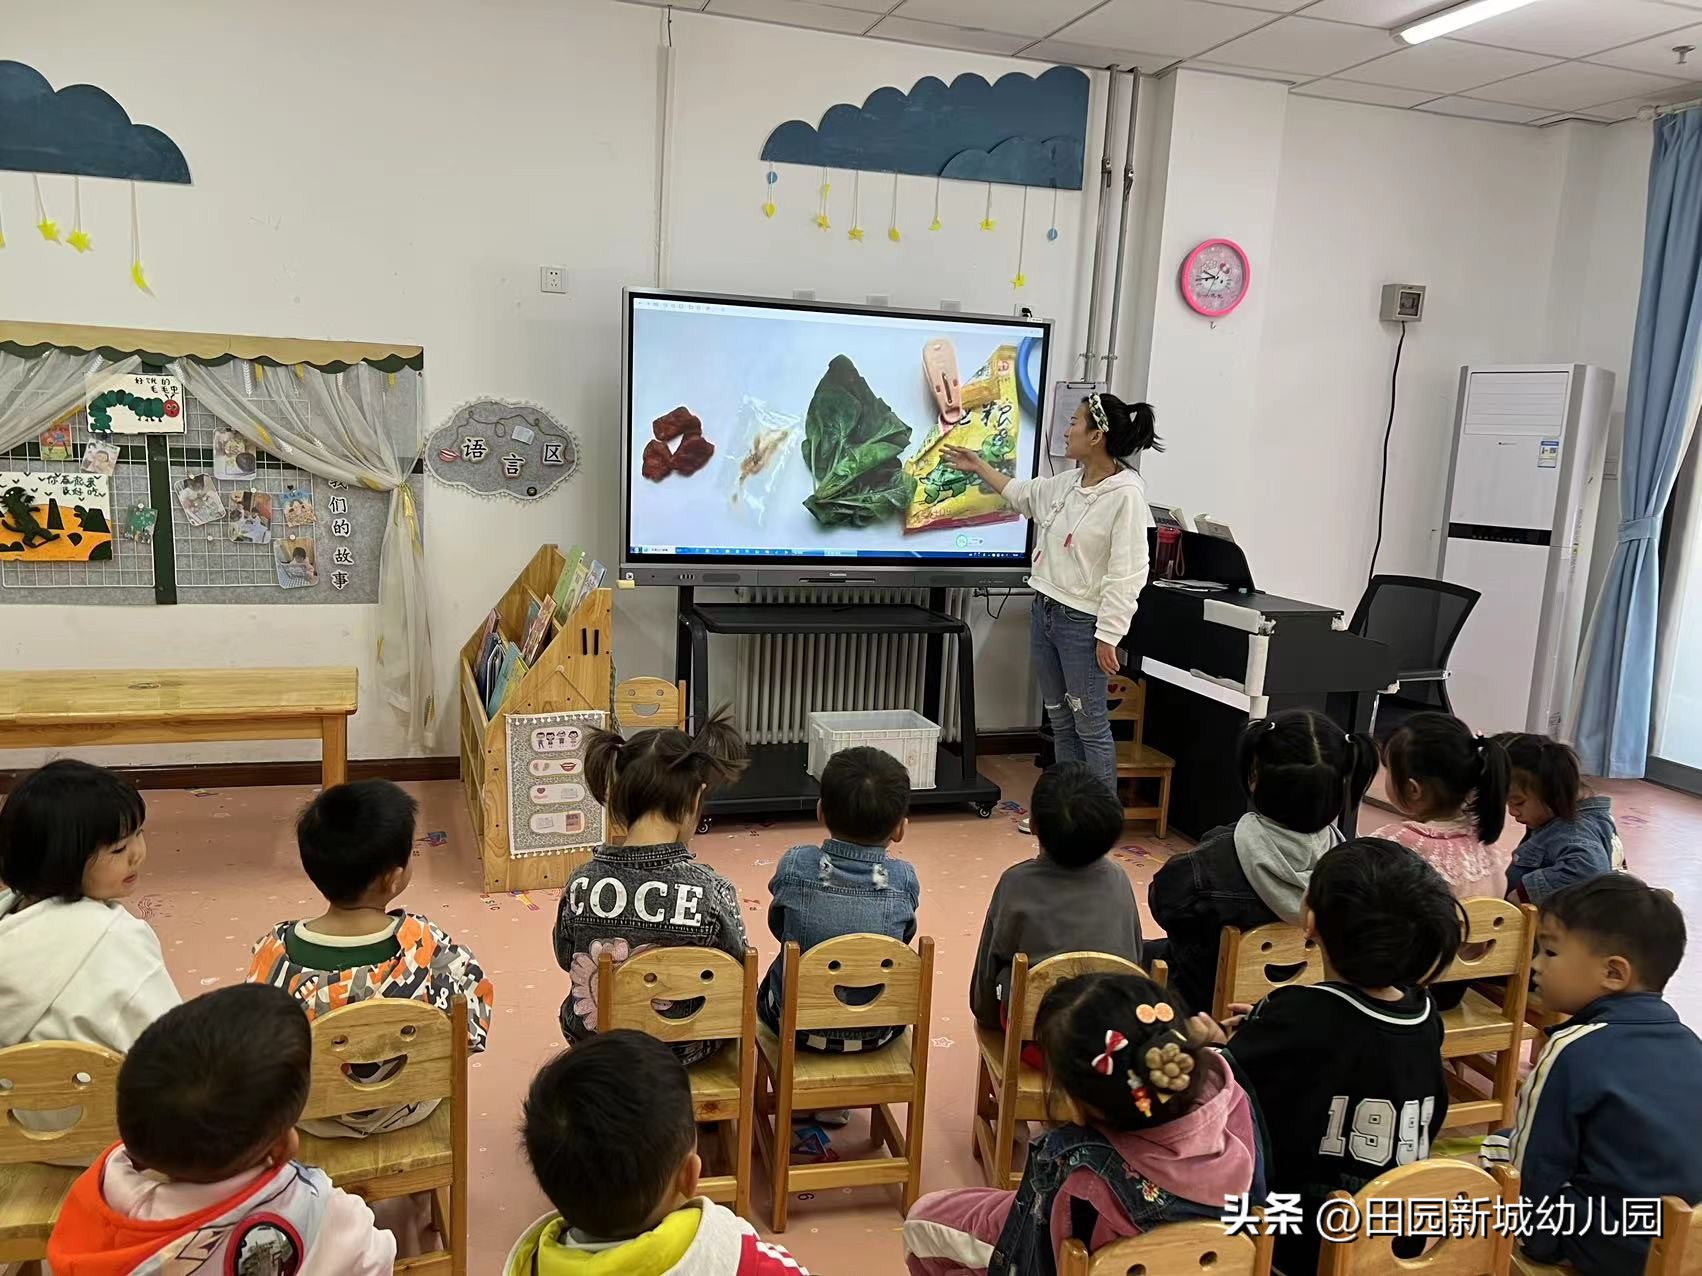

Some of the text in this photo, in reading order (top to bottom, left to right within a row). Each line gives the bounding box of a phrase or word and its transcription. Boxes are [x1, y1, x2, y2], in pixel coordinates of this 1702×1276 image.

[463, 438, 563, 475] 语言区
[569, 876, 704, 927] COCE
